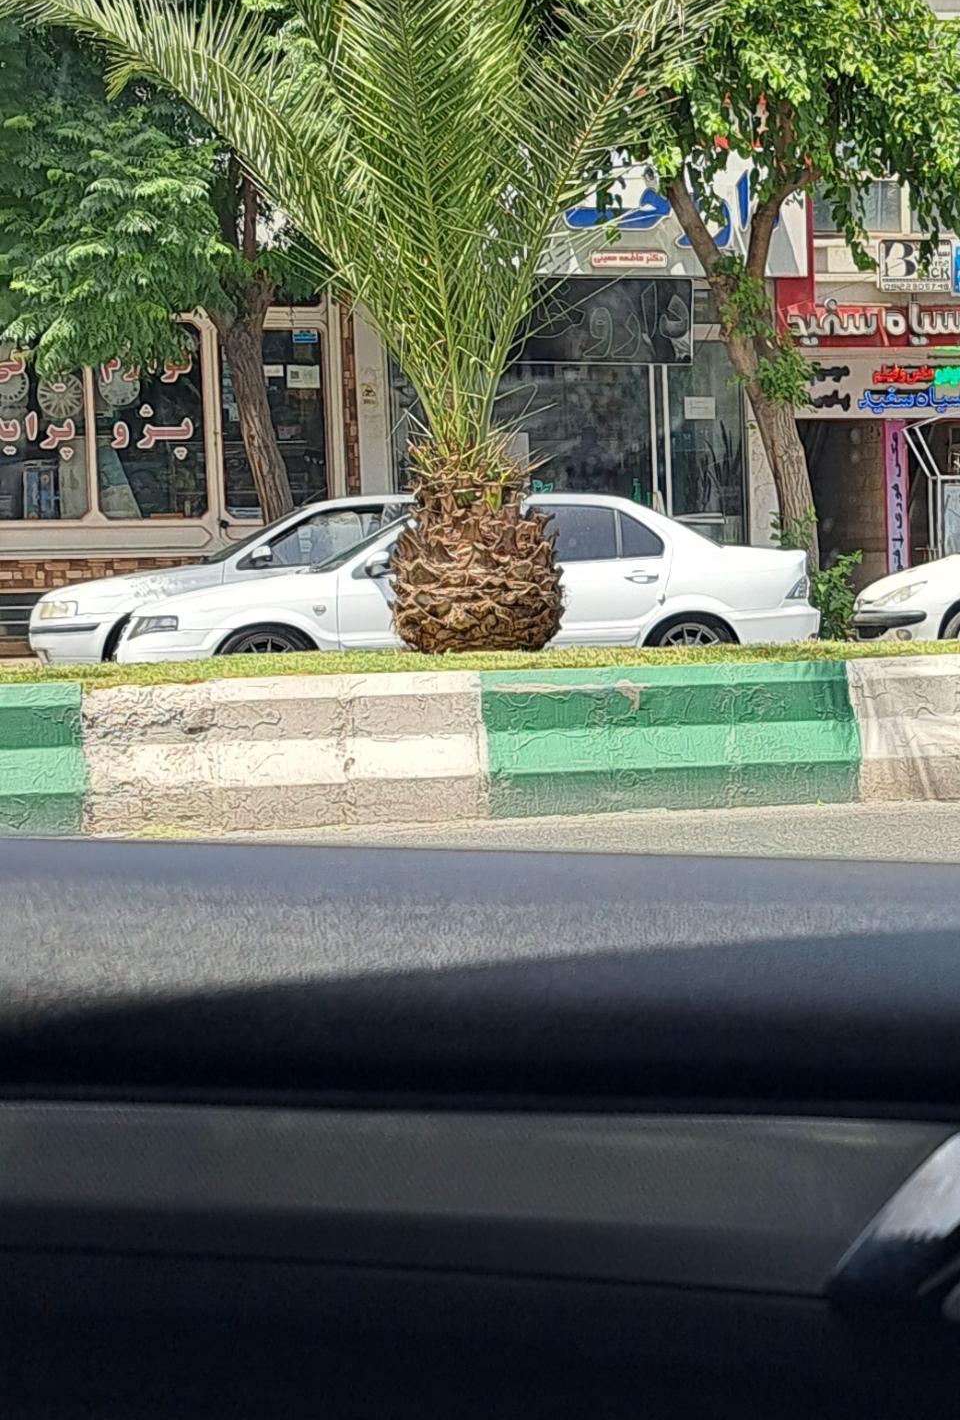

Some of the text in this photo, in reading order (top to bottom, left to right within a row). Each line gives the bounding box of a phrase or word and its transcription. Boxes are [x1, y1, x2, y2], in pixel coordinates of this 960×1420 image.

[787, 298, 879, 346] سفید
[858, 386, 915, 414] سفید
[110, 403, 194, 461] پژو
